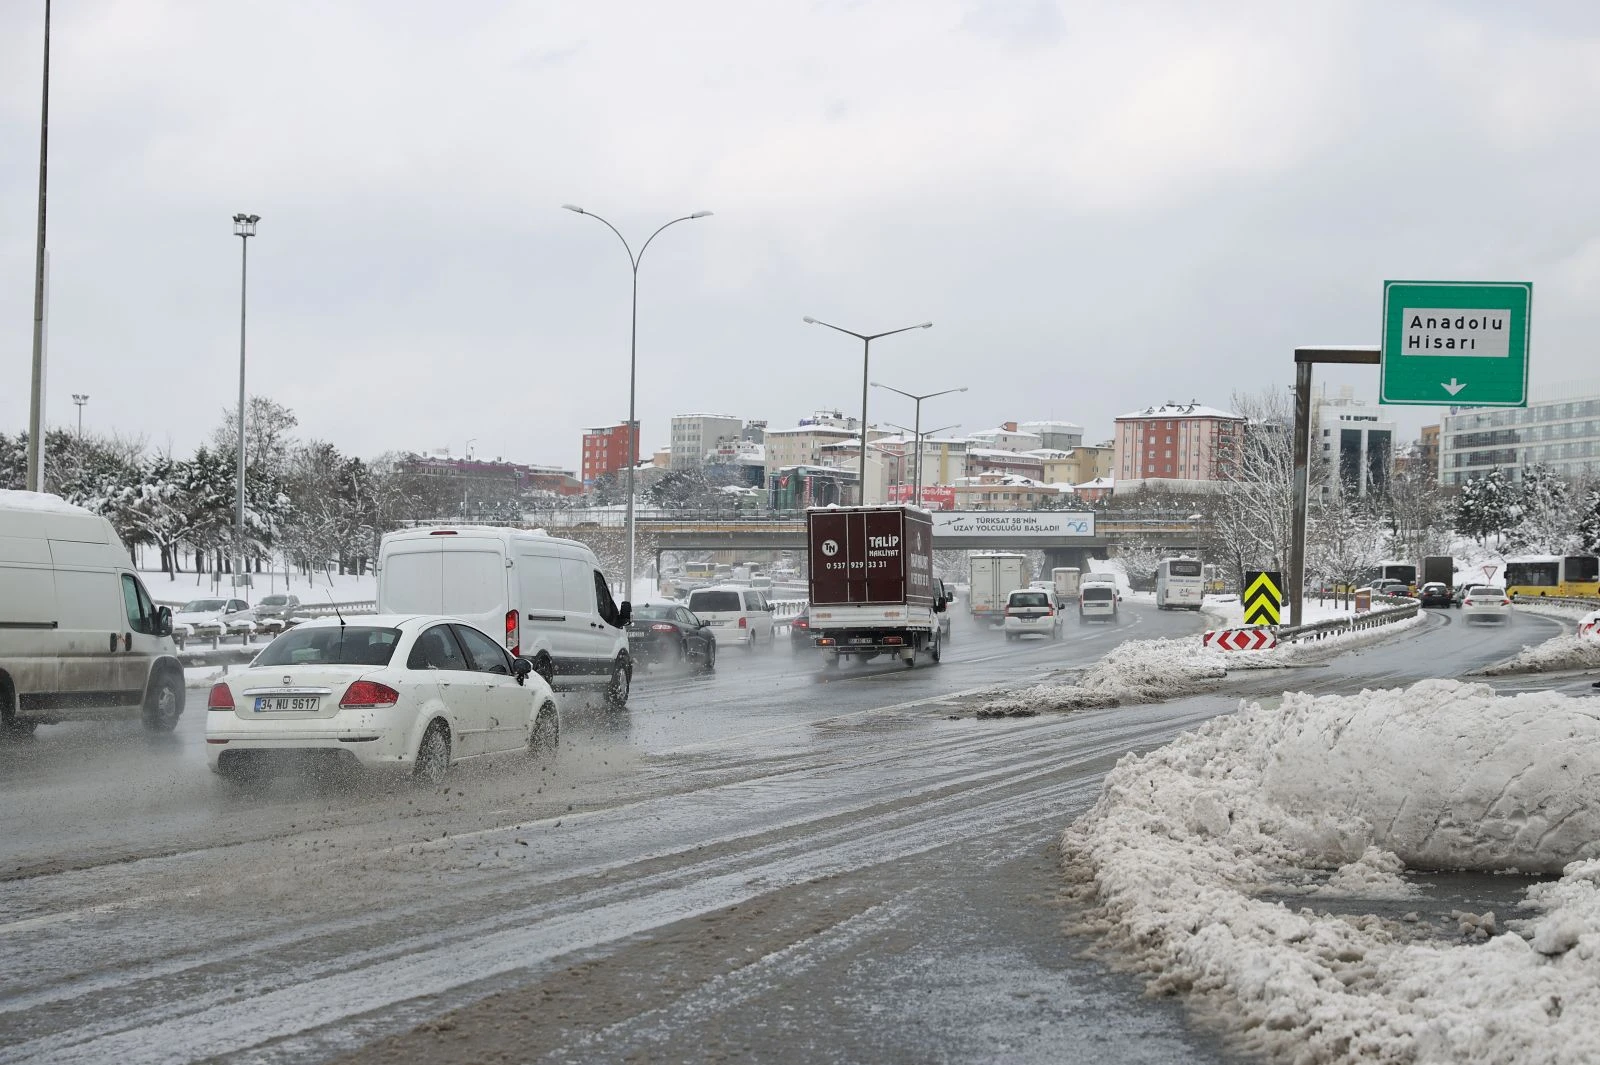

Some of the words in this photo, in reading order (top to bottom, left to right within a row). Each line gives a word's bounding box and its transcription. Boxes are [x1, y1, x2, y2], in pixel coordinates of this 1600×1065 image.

[1410, 315, 1502, 330] Anadolu
[1408, 335, 1475, 349] Hisarı
[976, 516, 1010, 524] TÜRKSAT
[976, 524, 1022, 532] YOLCULUĞU
[869, 534, 899, 548] TALİP
[824, 542, 836, 554] TN
[826, 562, 831, 570] 0
[850, 561, 864, 569] 929
[878, 560, 887, 568] 31
[260, 698, 272, 710] 34
[276, 698, 289, 710] NU
[292, 698, 317, 710] 9617
